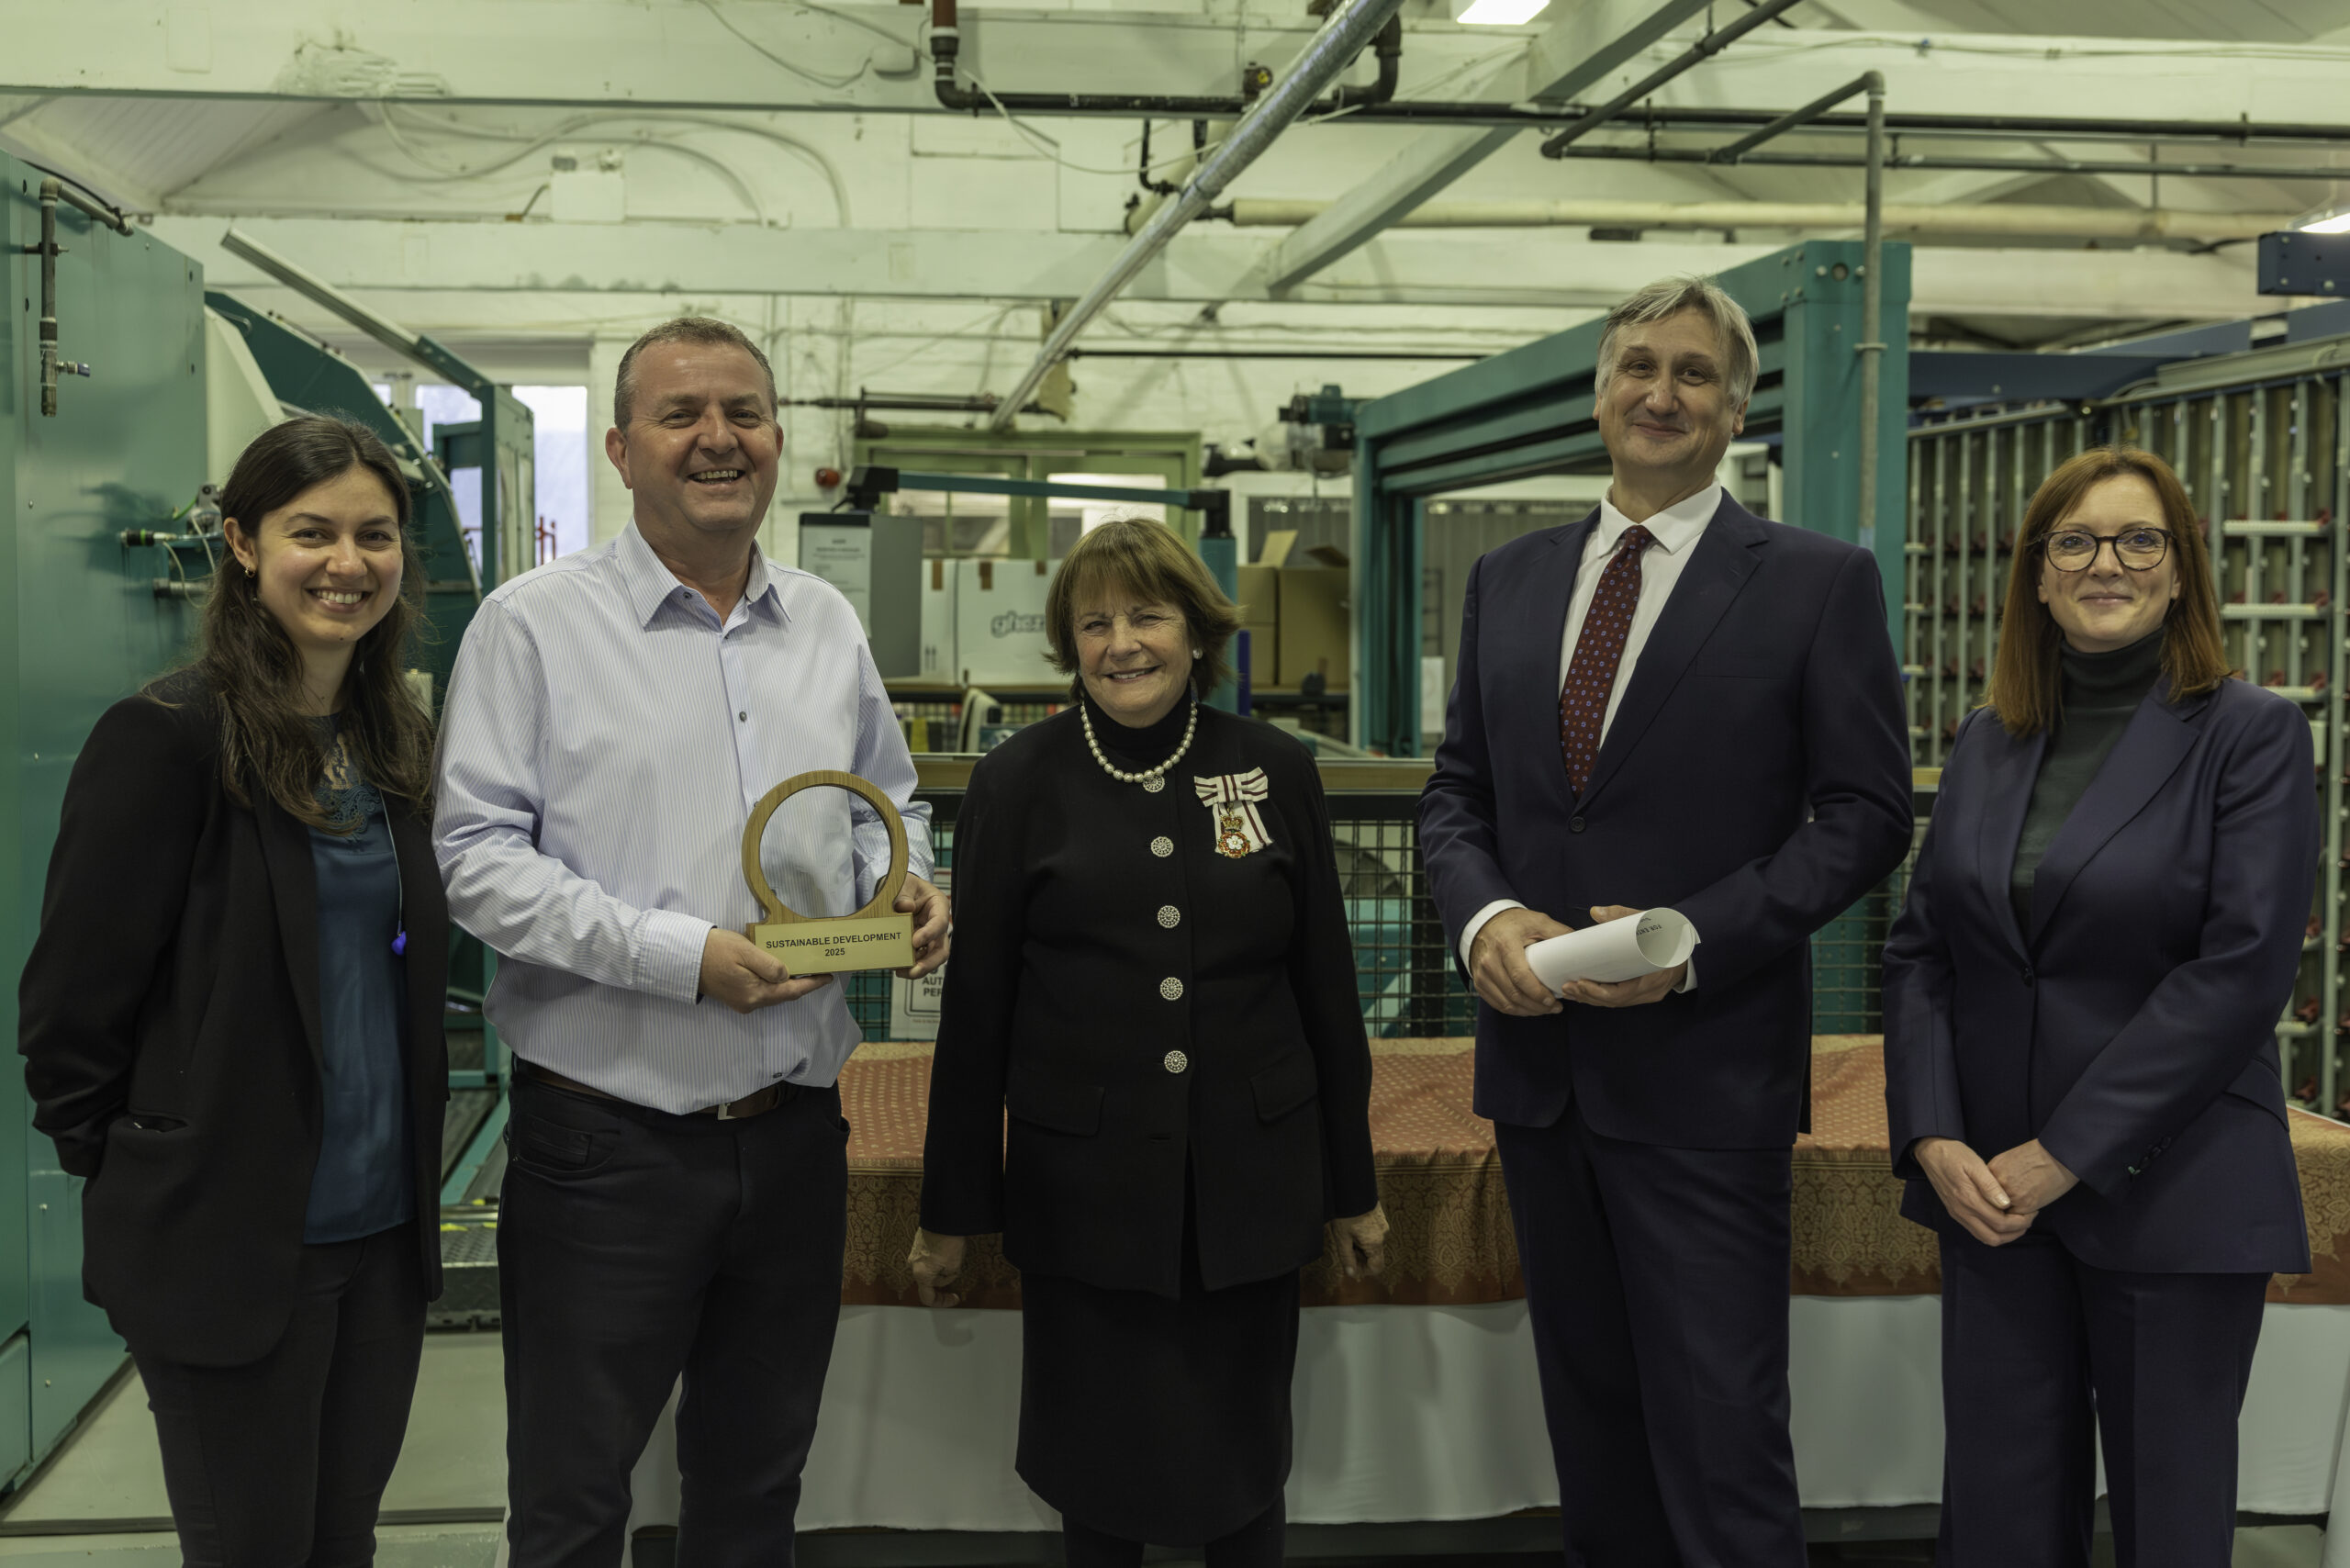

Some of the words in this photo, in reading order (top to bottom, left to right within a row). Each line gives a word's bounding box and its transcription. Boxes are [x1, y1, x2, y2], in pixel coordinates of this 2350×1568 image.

[766, 937, 831, 948] SUSTAINABLE
[833, 932, 901, 945] DEVELOPMENT
[824, 947, 845, 957] 2025
